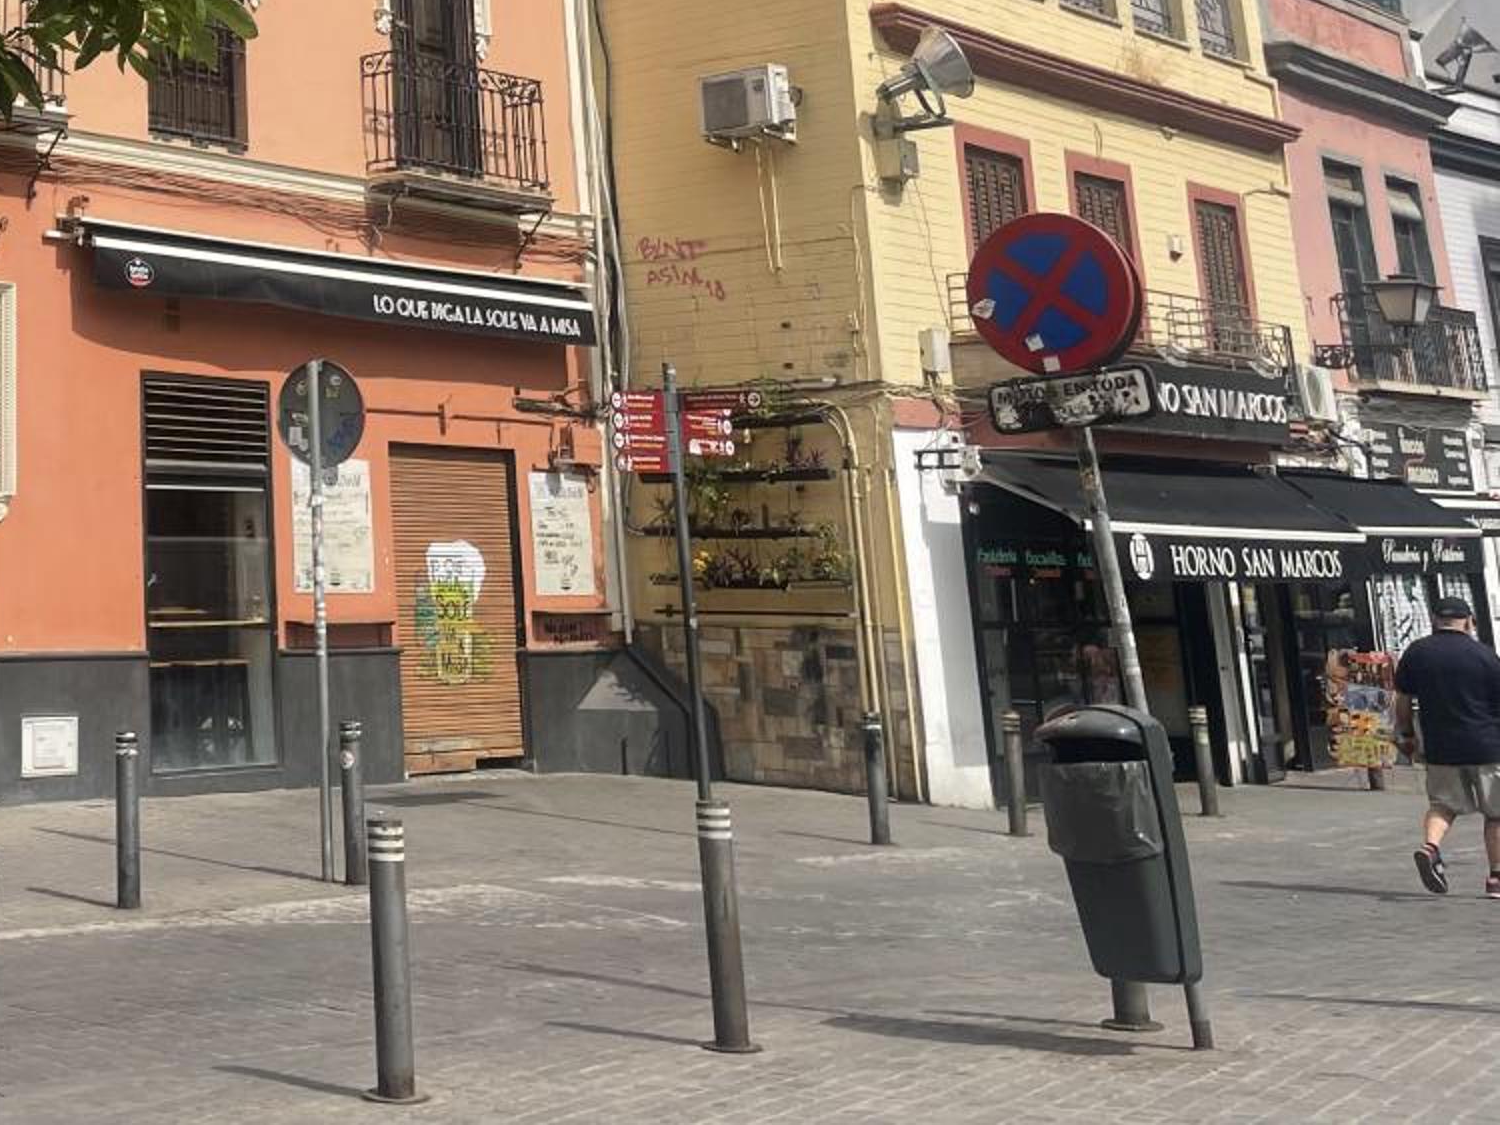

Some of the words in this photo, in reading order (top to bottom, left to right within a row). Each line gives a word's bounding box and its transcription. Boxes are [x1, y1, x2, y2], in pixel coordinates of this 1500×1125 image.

[373, 294, 394, 314] LO
[396, 297, 428, 320] QUE
[431, 302, 464, 323] DIGA
[465, 306, 484, 326] LA
[485, 308, 518, 330] SOLE
[519, 312, 538, 332] VA
[540, 316, 550, 333] A
[551, 317, 581, 337] MISA
[1182, 384, 1218, 417] SAN
[1169, 544, 1237, 578] HORNO
[1241, 546, 1276, 578] SAN
[1280, 549, 1343, 578] MARCOS
